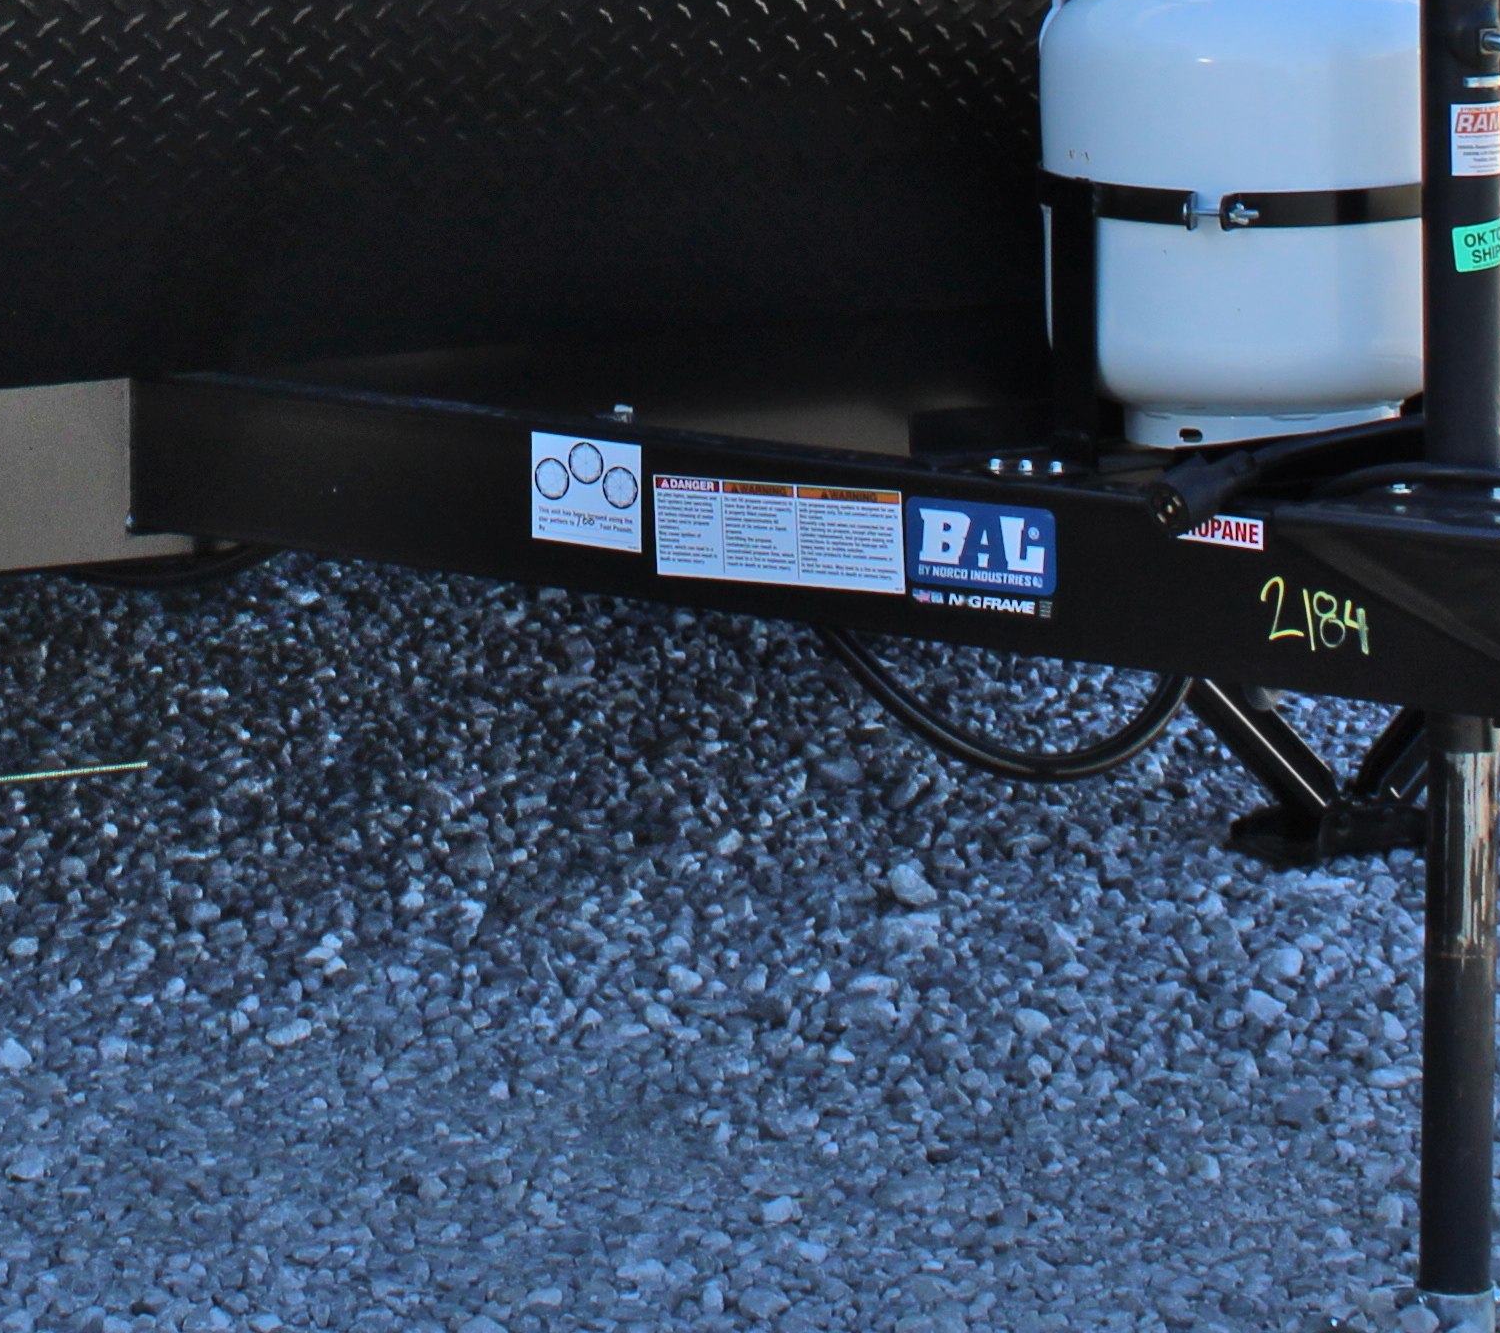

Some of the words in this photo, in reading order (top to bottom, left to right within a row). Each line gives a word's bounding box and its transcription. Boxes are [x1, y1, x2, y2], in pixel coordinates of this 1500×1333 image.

[1463, 231, 1488, 248] OK
[1471, 244, 1500, 263] SHIP
[669, 479, 714, 491] DANGER
[919, 508, 1045, 573] BAL
[918, 564, 931, 576] BY
[932, 566, 968, 580] NORCO
[970, 570, 1032, 587] INDUSTRIES
[982, 596, 1035, 614] FRAME
[1260, 576, 1369, 655] 2184
